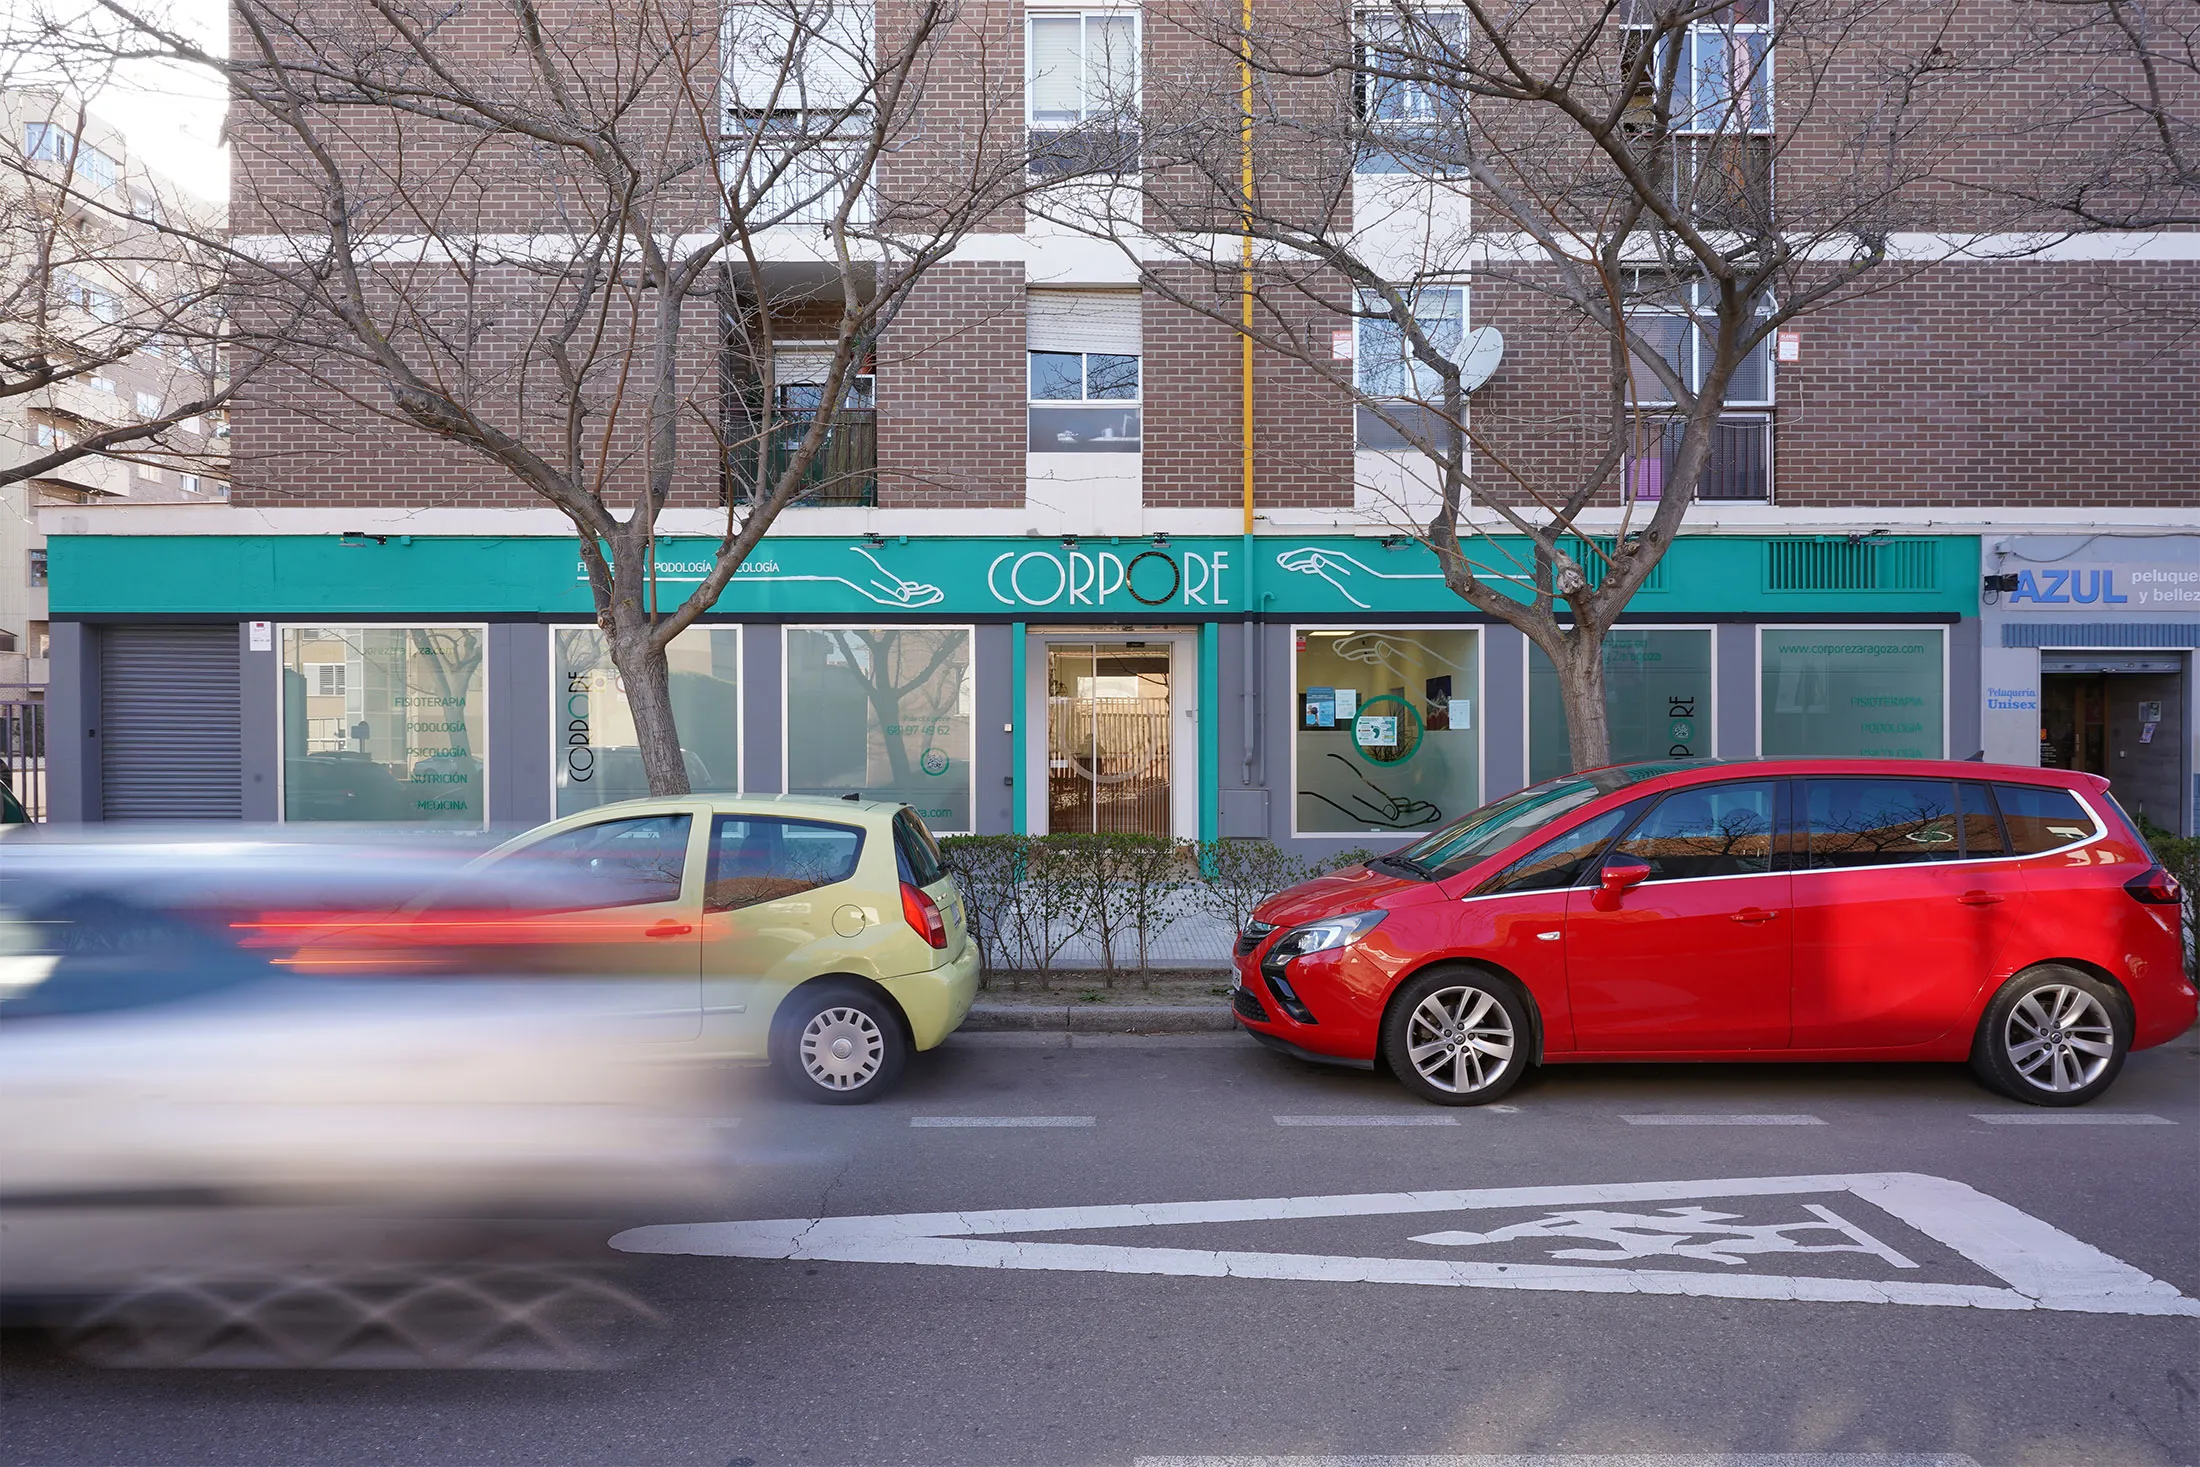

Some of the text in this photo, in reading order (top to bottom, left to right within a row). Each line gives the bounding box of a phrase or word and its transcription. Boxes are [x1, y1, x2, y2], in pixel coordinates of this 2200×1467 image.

[655, 560, 713, 573] PODOLOGÍA
[987, 551, 1229, 606] CORPORE
[2132, 569, 2200, 585] peluque
[2009, 570, 2128, 604] AZUL
[2139, 591, 2149, 604] y
[1778, 643, 1924, 657] www.corporezaragoza.com
[394, 697, 467, 707] FISIOTERAPIA
[1987, 699, 2037, 709] Unisex
[407, 720, 467, 732] PODOLOGÍA
[937, 725, 951, 735] 62
[1669, 696, 1694, 760] PORE
[406, 745, 468, 757] PSICOLOGÍA
[410, 772, 468, 783] NUTRICIÓN
[417, 800, 468, 810] MEDICINA
